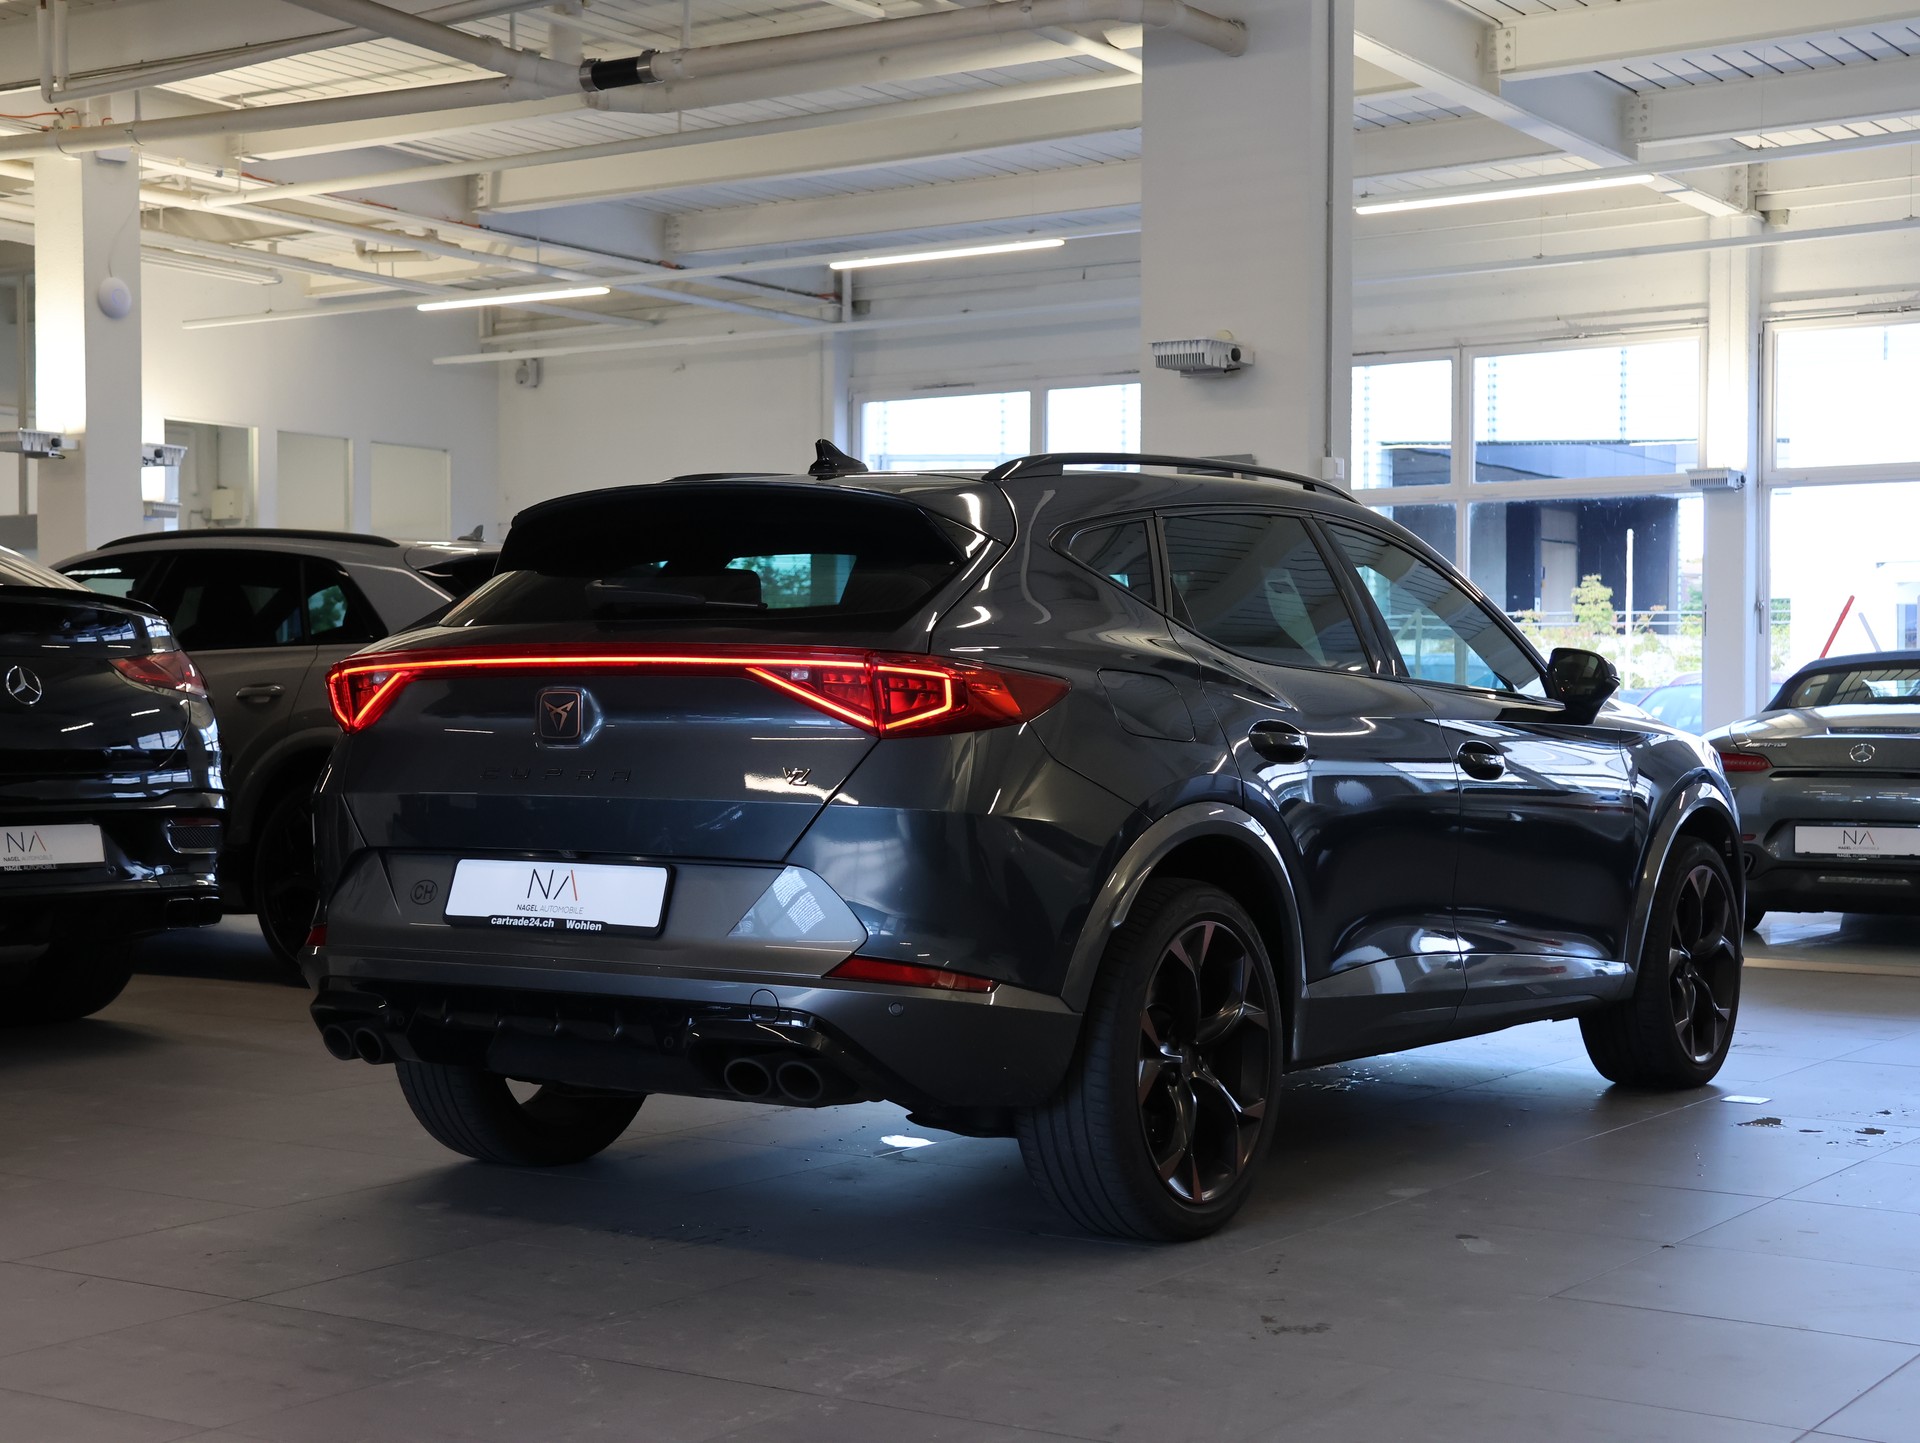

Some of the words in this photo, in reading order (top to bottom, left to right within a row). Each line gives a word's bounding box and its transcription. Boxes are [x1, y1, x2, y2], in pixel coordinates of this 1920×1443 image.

[480, 767, 632, 781] CUPRA
[783, 767, 811, 786] VZ
[414, 884, 435, 900] CH
[516, 904, 539, 912] NAGEL
[540, 905, 584, 915] AUTOMOBILE
[491, 916, 555, 928] cartrade24.ch
[566, 919, 602, 931] Wohlen
